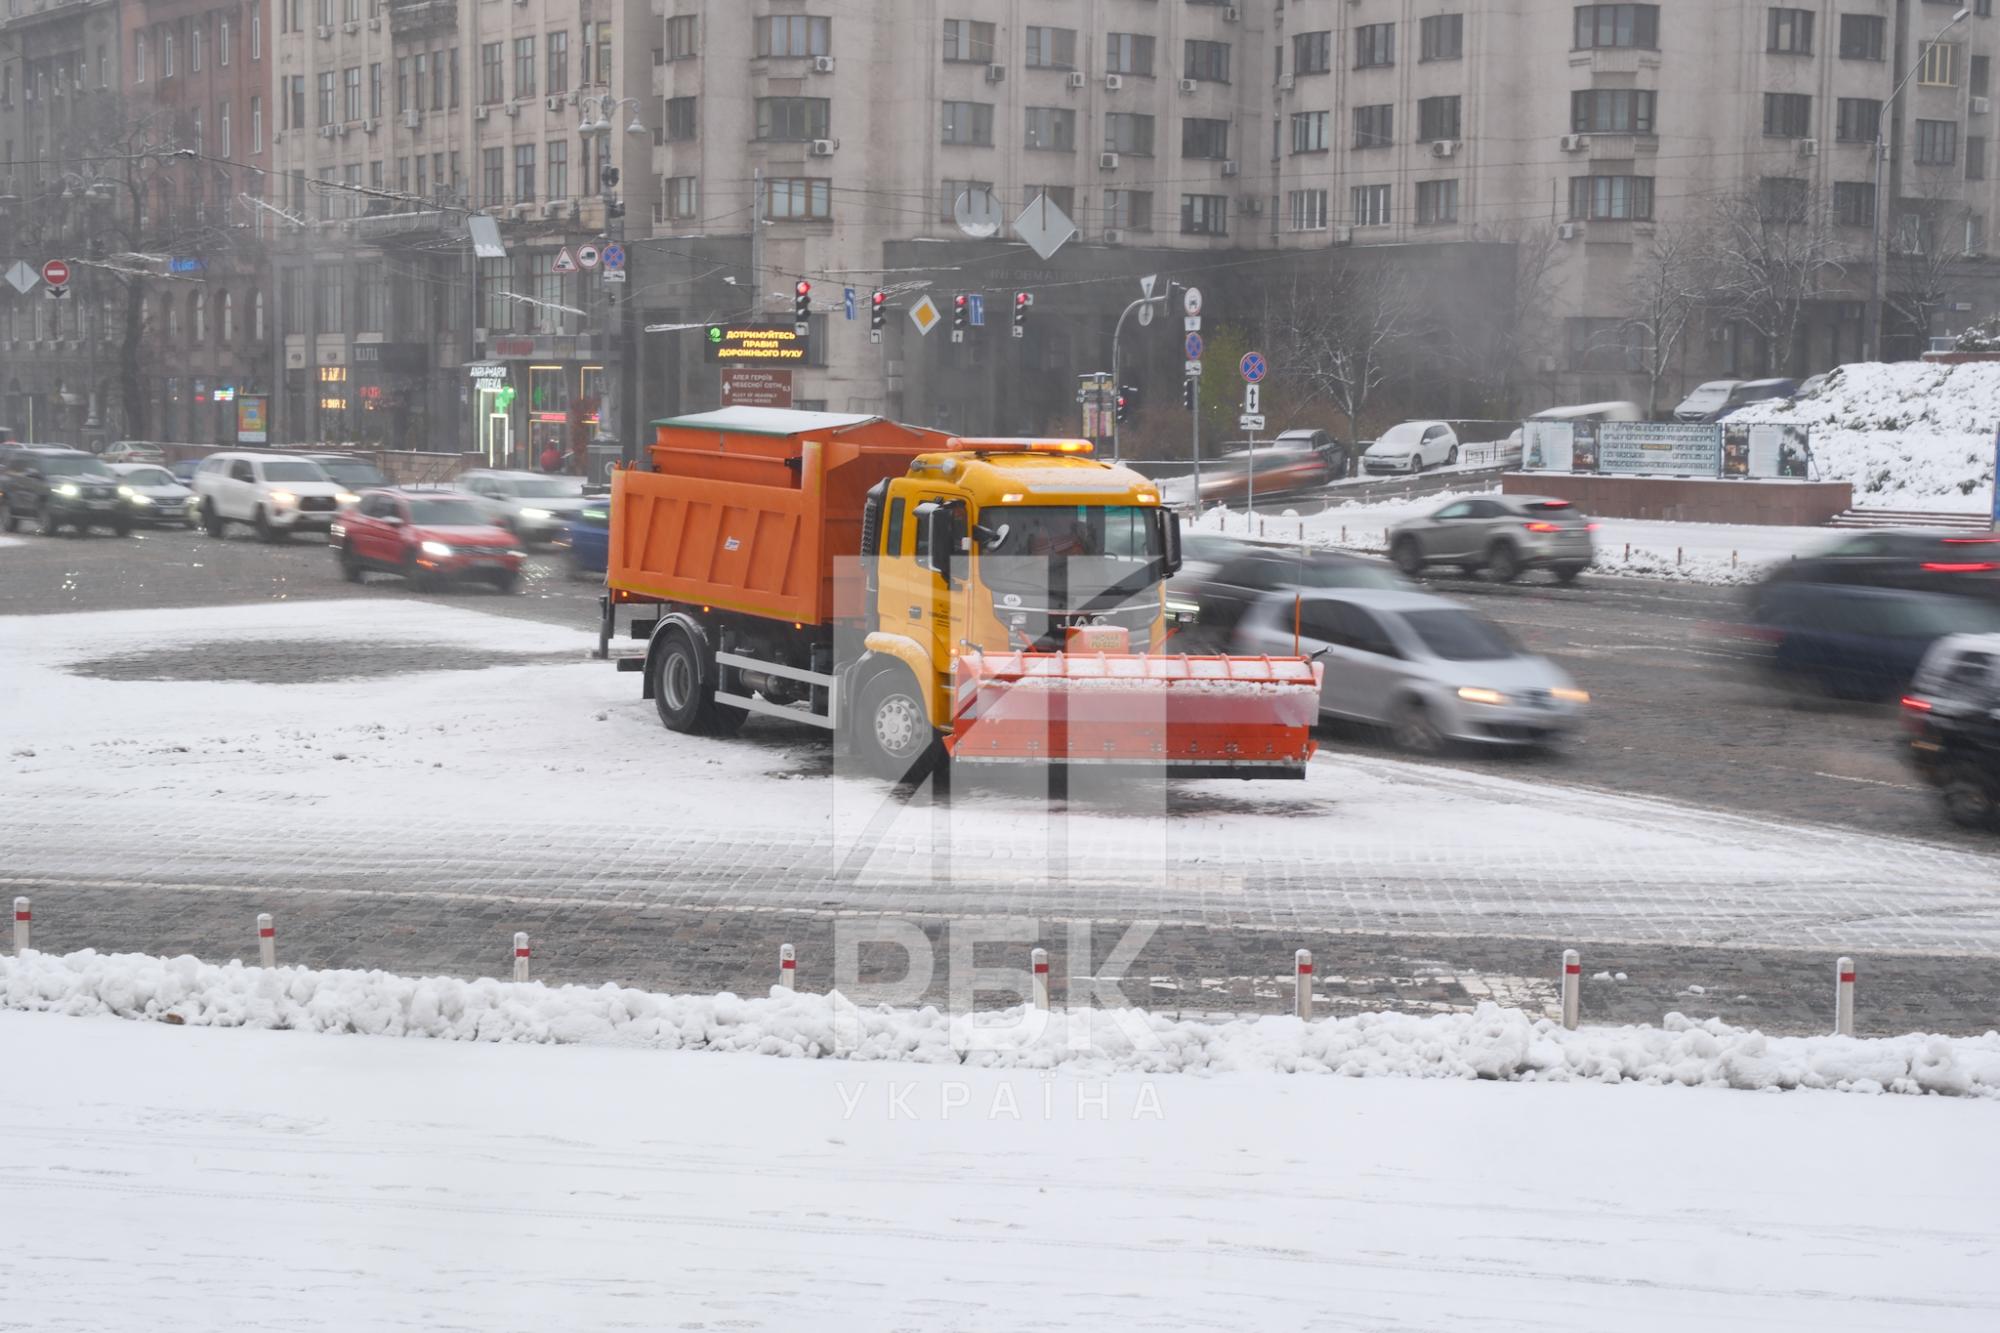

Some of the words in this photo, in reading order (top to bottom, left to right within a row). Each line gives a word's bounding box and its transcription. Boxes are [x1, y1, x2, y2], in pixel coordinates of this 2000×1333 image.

[726, 330, 796, 340] ДОТРИМУЙТЕСЬ
[742, 340, 779, 348] ПРАВИЛ
[718, 349, 780, 358] ДОРОЖНЬОГО
[780, 350, 804, 358] РУХУ
[474, 378, 501, 390] АПТЕКА
[732, 381, 763, 389] НЕБЕСНОЇ
[1056, 615, 1107, 628] JAC
